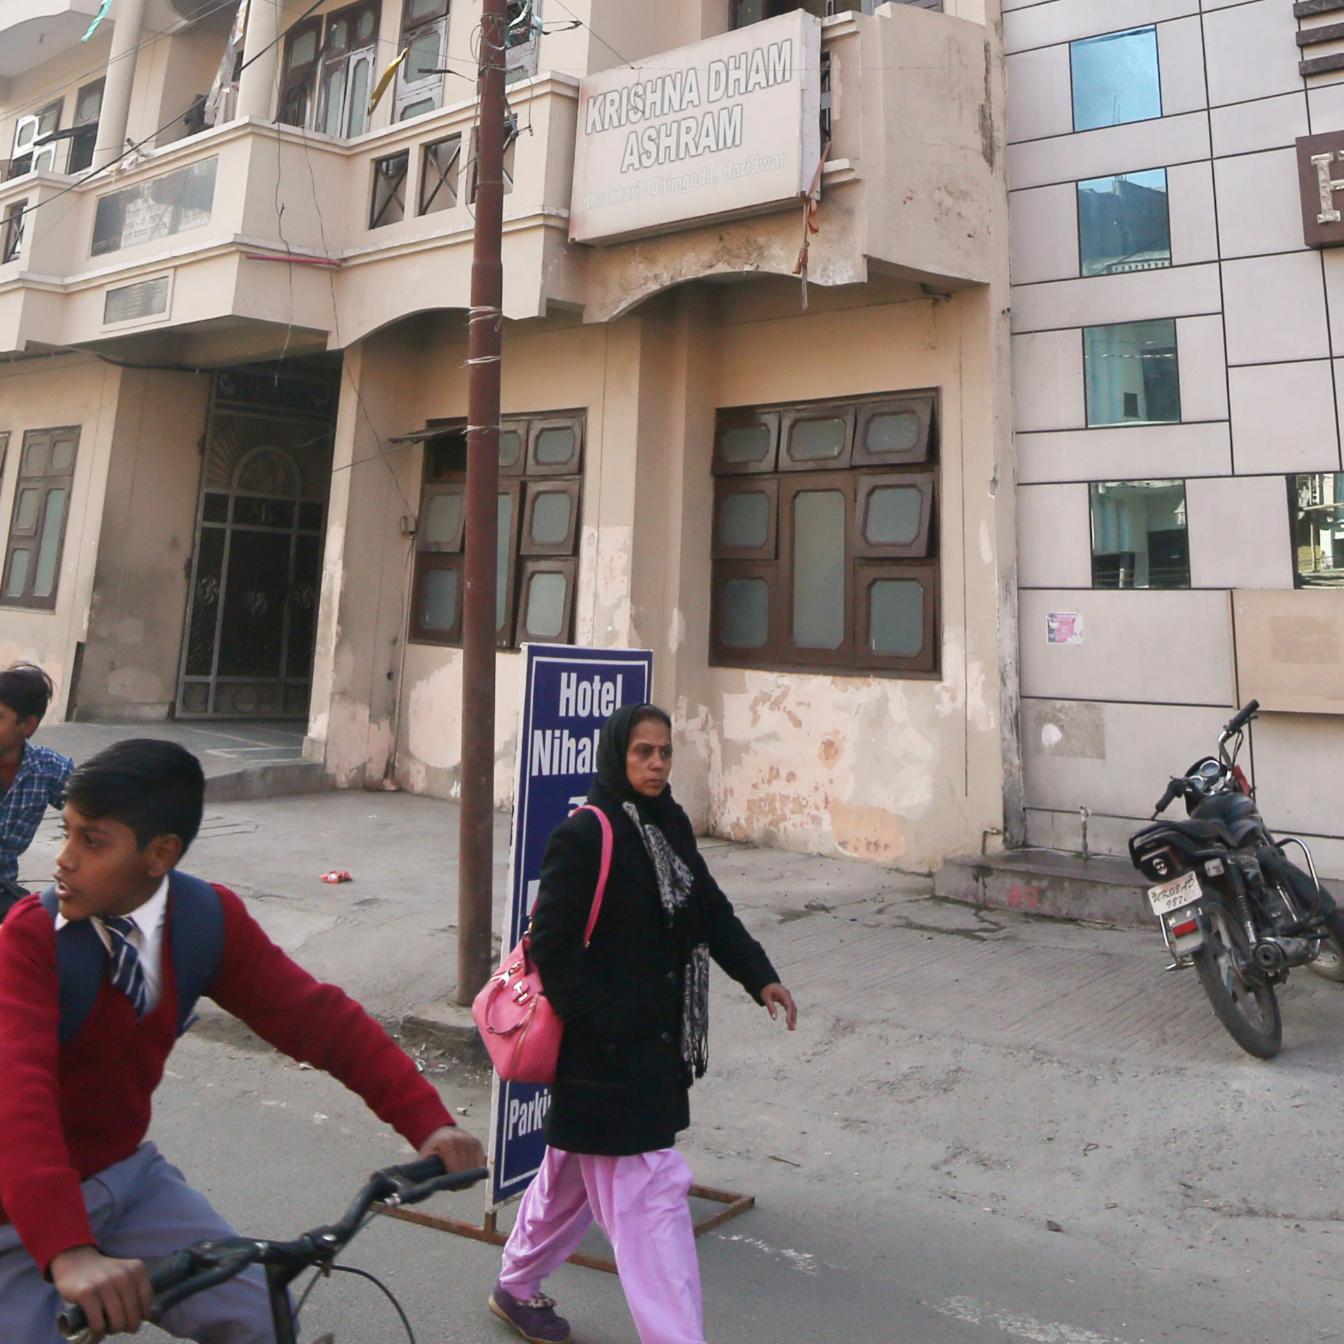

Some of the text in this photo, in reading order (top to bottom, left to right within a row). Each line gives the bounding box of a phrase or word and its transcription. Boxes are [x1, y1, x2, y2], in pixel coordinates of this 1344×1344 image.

[585, 38, 793, 135] KRISHNA DHAM
[620, 103, 744, 173] ASHRAM
[558, 672, 623, 717] Hotel
